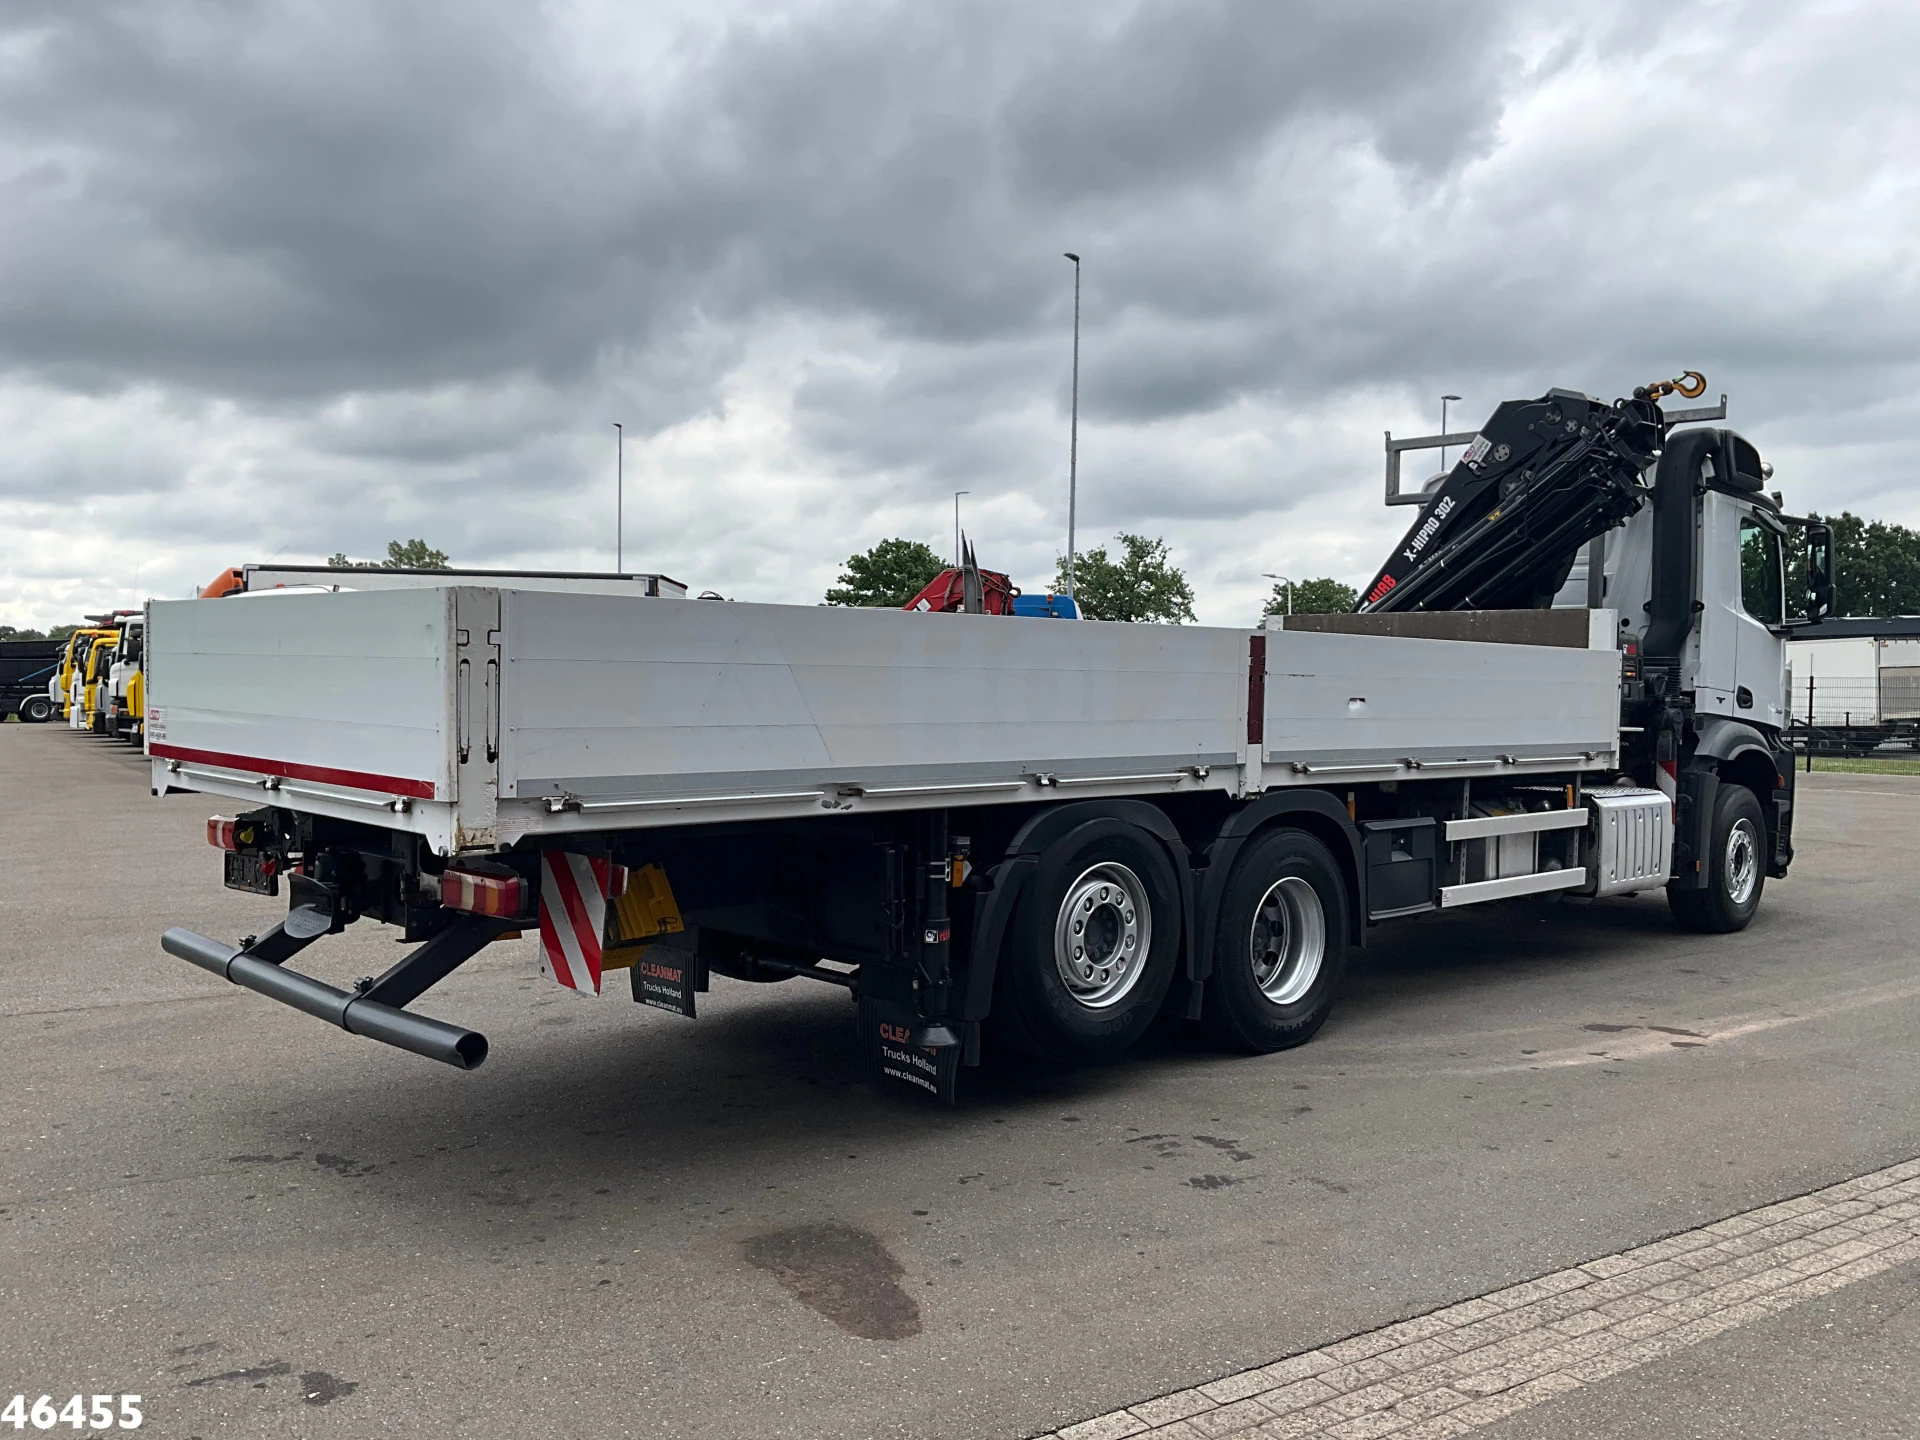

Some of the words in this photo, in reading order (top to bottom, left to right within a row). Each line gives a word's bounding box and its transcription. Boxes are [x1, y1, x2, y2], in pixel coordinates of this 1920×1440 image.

[1403, 516, 1440, 562] X-HIPRO
[1434, 496, 1456, 520] 302
[640, 962, 682, 983] CLEANMAT
[643, 981, 662, 994] Trucks
[661, 985, 682, 999] Holland
[882, 1046, 910, 1063] Trucks
[912, 1054, 937, 1076] Holland
[883, 1066, 938, 1094] www.cleanmat.eu
